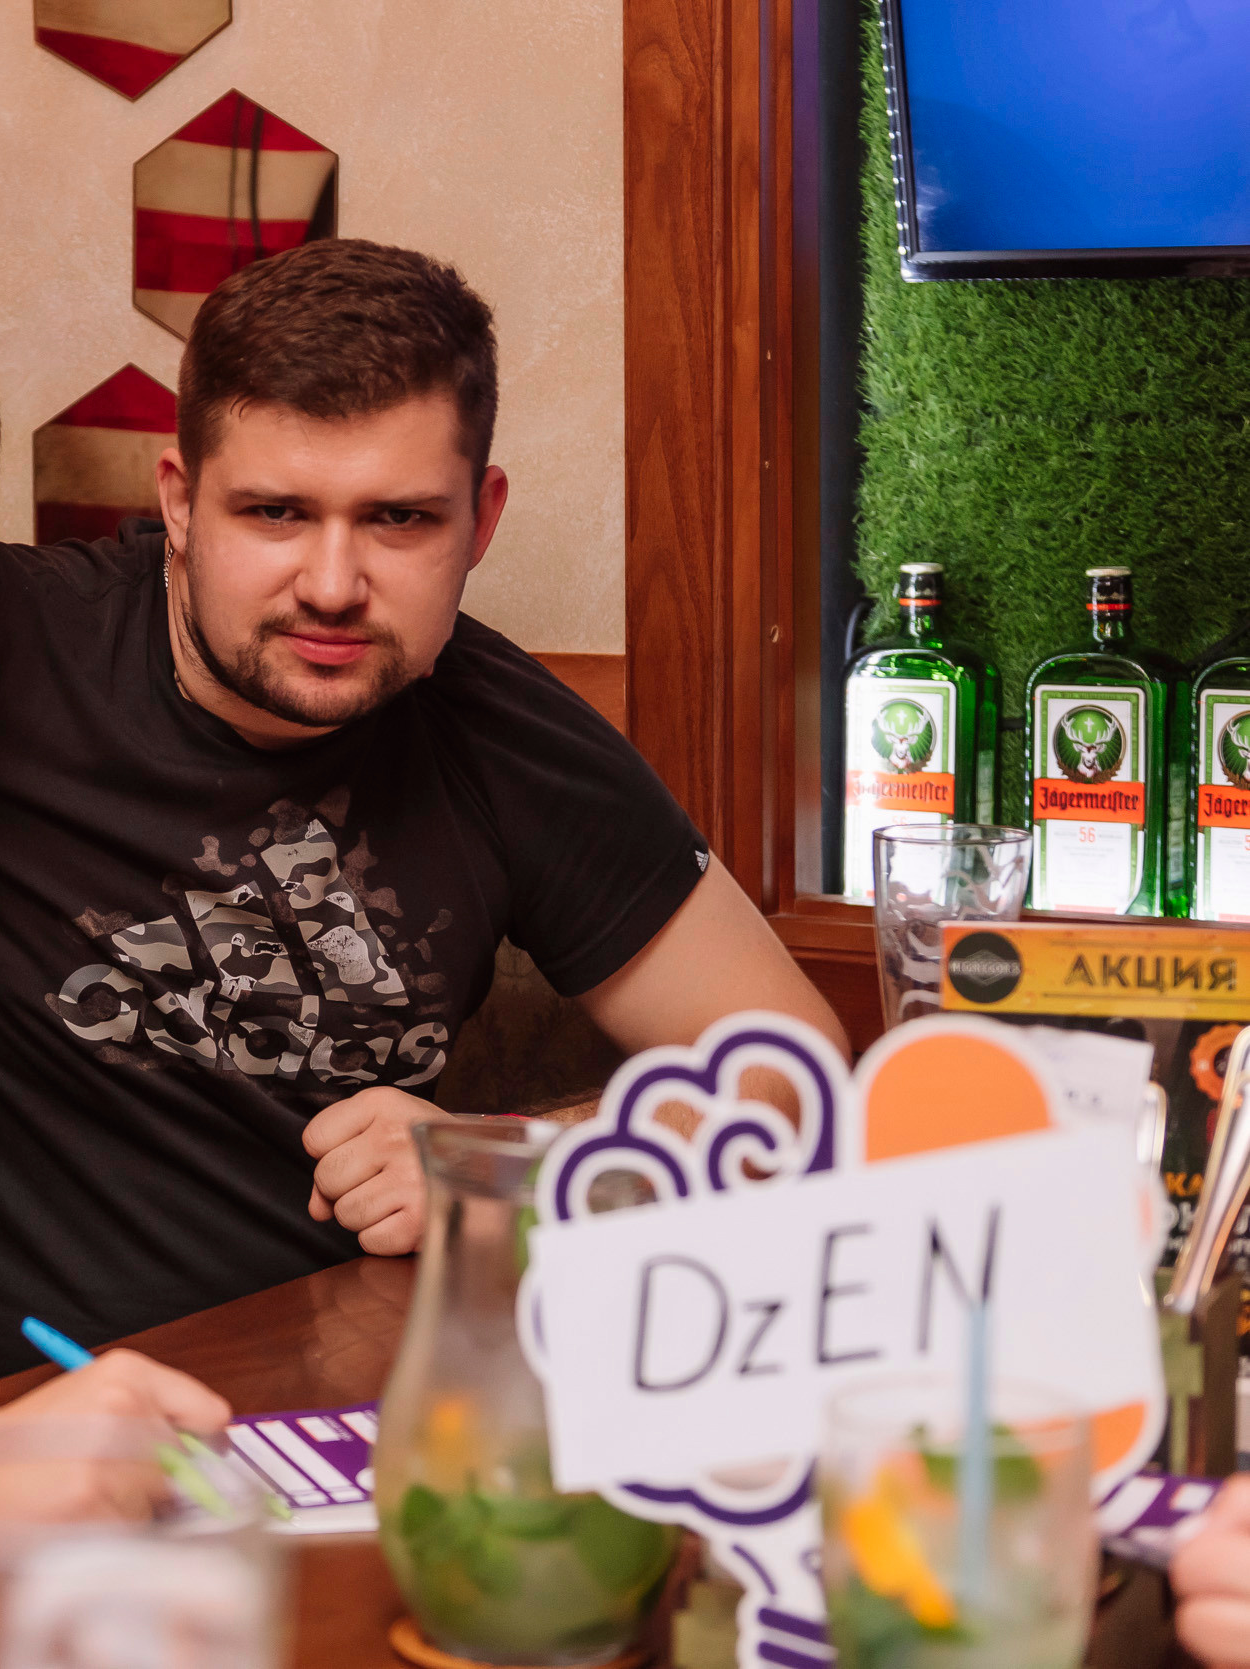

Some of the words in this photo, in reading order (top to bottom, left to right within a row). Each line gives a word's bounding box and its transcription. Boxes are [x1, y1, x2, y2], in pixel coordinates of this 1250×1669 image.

[1039, 786, 1139, 814] Jägermeister
[1078, 826, 1096, 843] 56
[1063, 953, 1237, 993] АКЦИЯ
